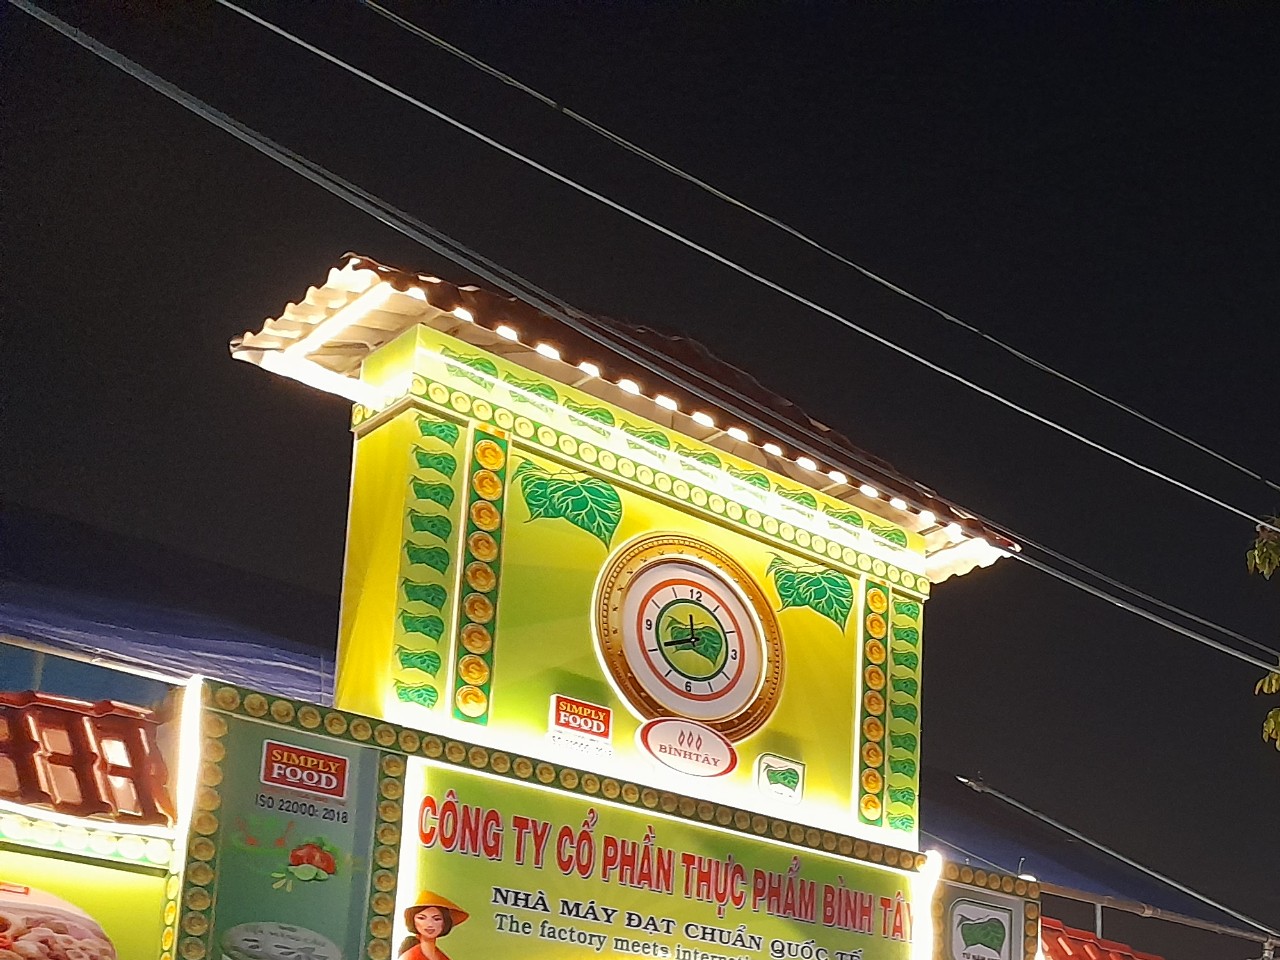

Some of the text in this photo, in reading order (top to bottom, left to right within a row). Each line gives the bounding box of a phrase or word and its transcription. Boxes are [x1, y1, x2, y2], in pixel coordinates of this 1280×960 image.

[689, 588, 703, 602] 12
[645, 618, 653, 630] 9
[730, 649, 738, 660] 3
[684, 681, 692, 692] 6
[558, 701, 607, 721] SIMPLY
[558, 711, 606, 734] FOOD
[271, 749, 341, 774] SIMPLY
[658, 744, 721, 768] BÌNHTÂY
[271, 762, 338, 790] FOOD
[255, 794, 274, 809] ISO
[321, 807, 349, 824] 2018
[418, 789, 503, 861] CÔNG
[512, 814, 552, 870] TY
[556, 807, 599, 879] CỔ
[601, 824, 675, 895] PHẦN
[681, 853, 747, 919] THỰC
[752, 856, 816, 924] PHẨM
[822, 876, 876, 935] BÌNH
[491, 887, 551, 913] NHÀ
[559, 899, 618, 924] MÁY
[625, 911, 677, 935] ĐẠT
[684, 925, 763, 951] CHUẨN
[494, 913, 532, 935] The
[539, 919, 607, 952] factory
[613, 937, 670, 958] meets
